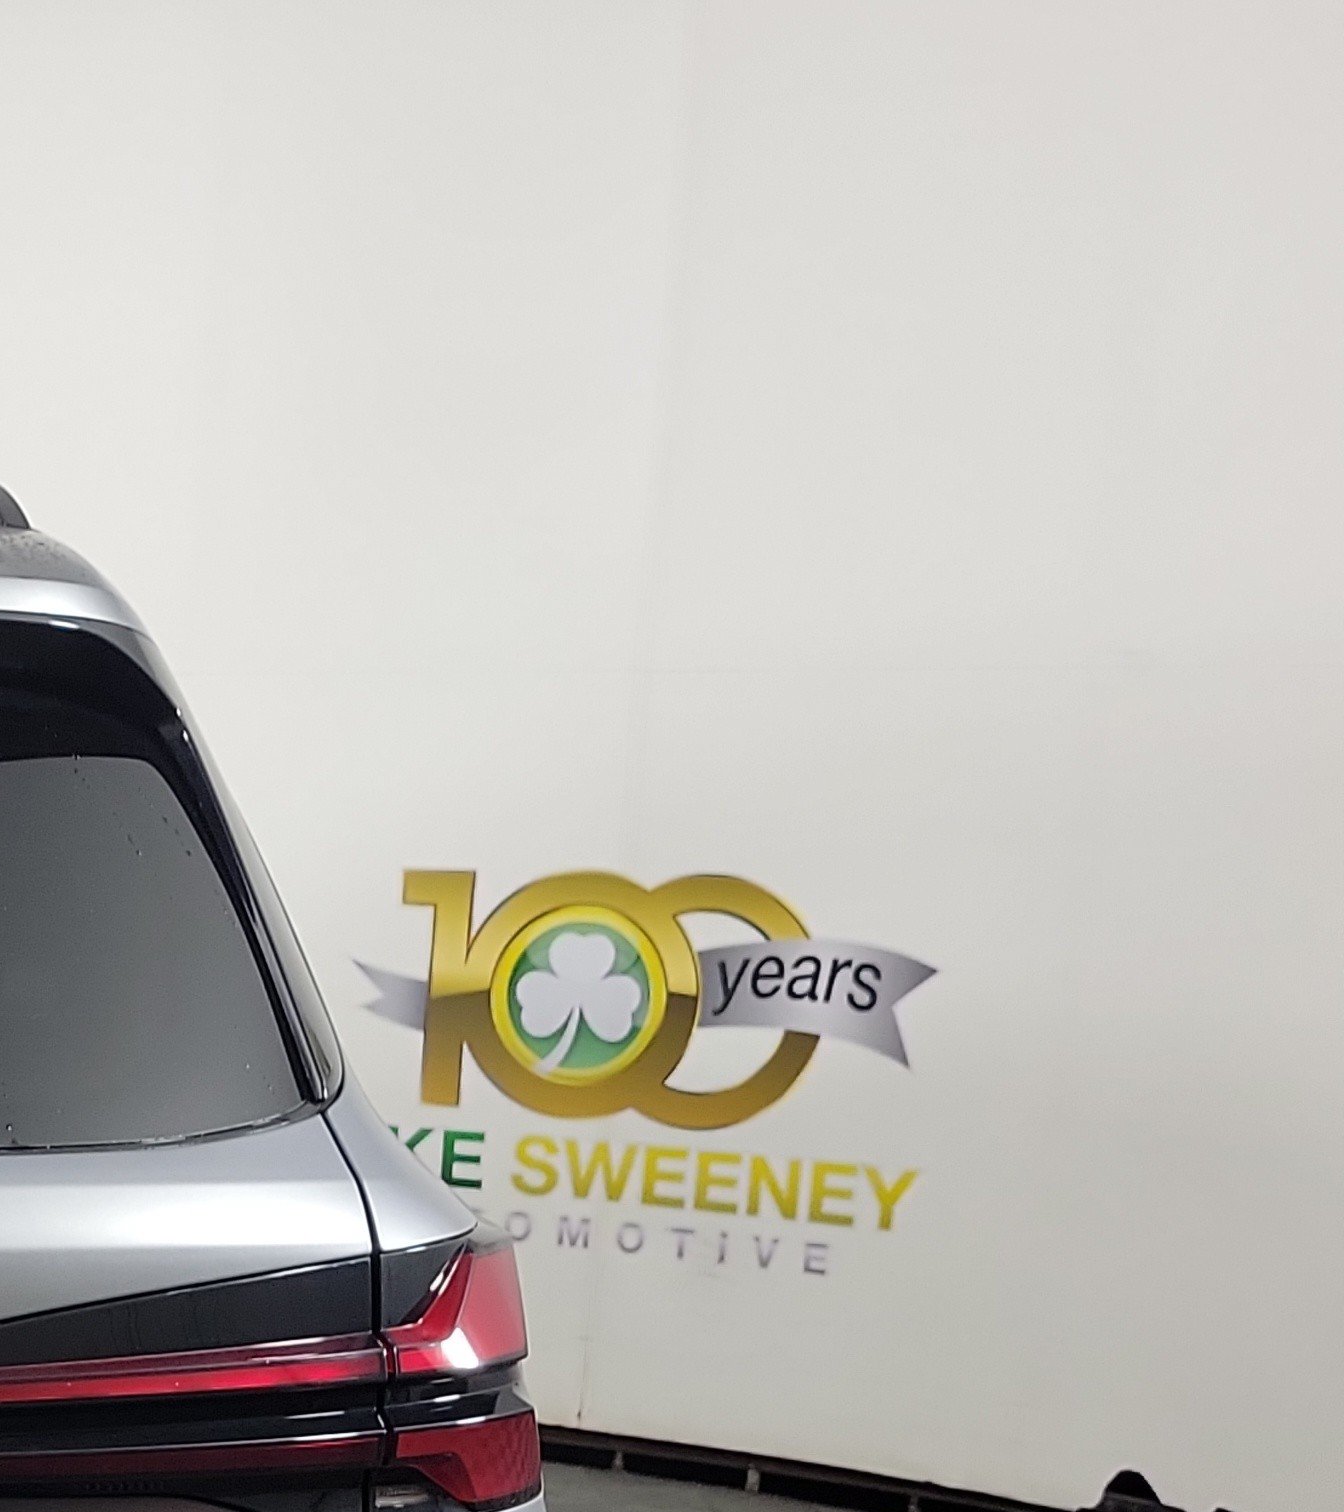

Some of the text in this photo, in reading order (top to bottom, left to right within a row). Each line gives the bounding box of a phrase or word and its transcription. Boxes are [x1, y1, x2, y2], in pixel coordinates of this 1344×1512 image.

[713, 951, 883, 1016] years
[511, 1133, 918, 1231] SWEENEY
[505, 1211, 831, 1275] OMOTIVE
